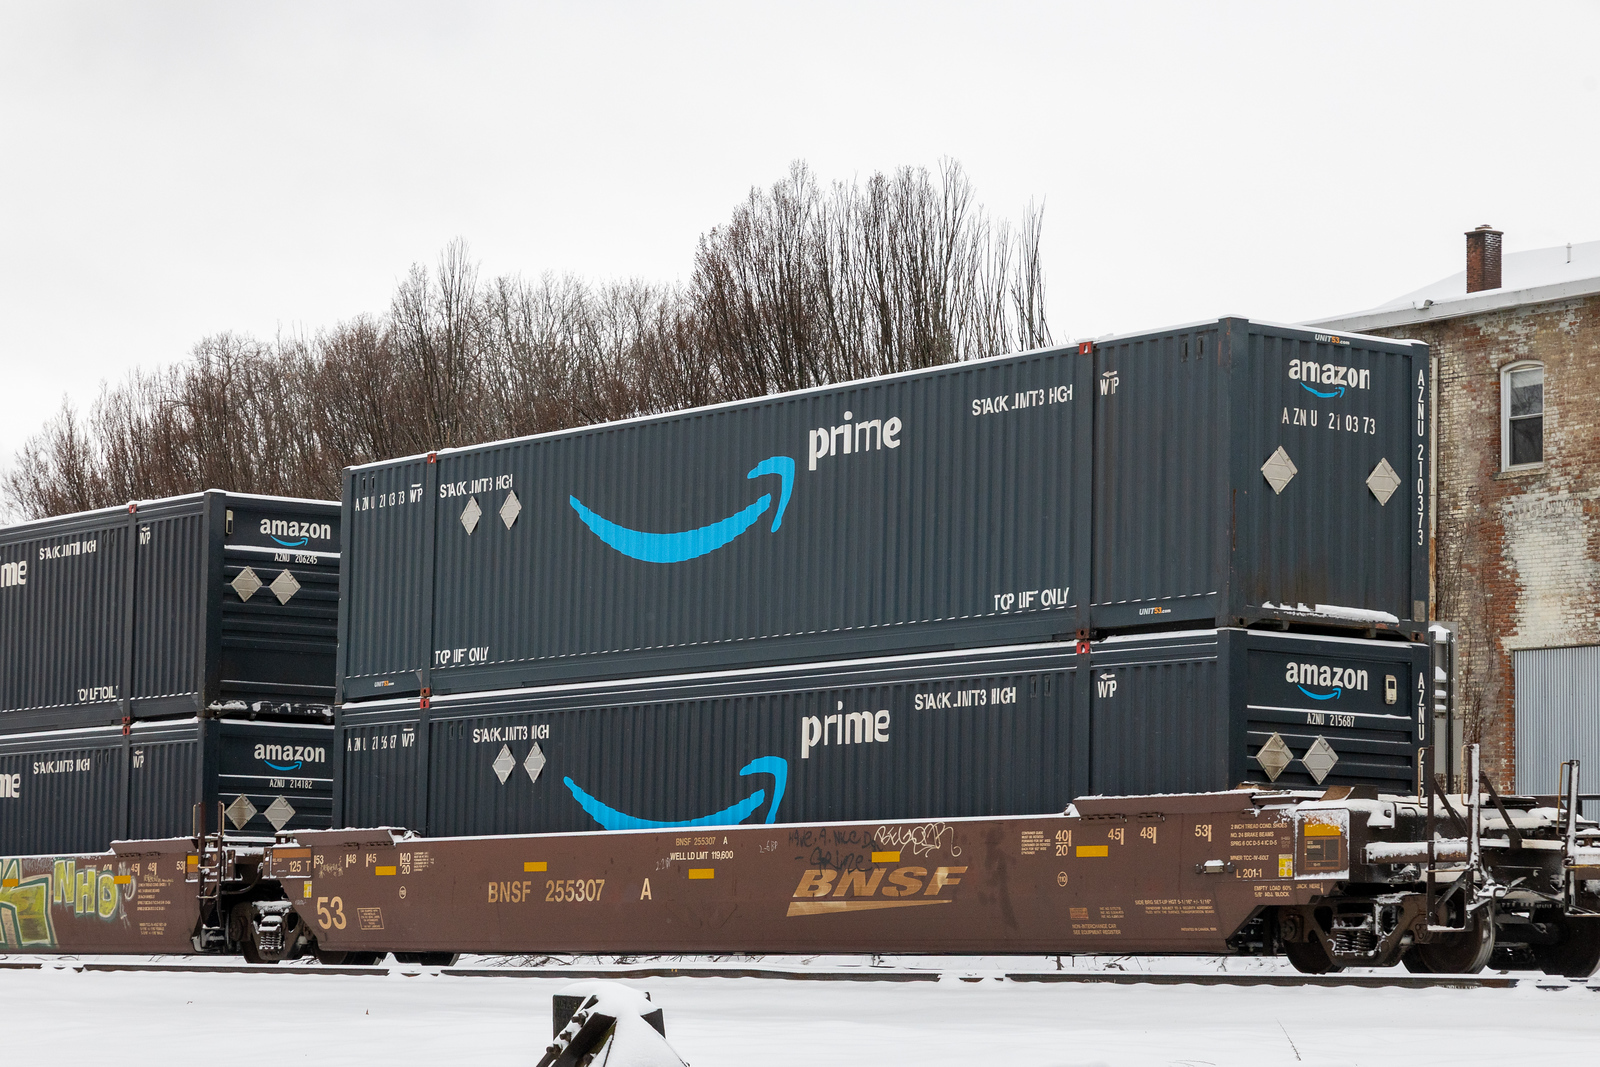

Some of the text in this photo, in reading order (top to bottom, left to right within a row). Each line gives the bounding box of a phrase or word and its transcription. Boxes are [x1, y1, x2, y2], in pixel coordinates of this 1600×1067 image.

[1288, 358, 1370, 389] amazon
[1417, 370, 1425, 436] AZNU
[1282, 406, 1376, 435] AZNU 210373
[808, 410, 902, 471] prime
[260, 518, 331, 540] amazon
[274, 553, 317, 564] AZNU 206245
[0, 561, 27, 587] me
[1286, 662, 1368, 691] amazon
[1307, 713, 1355, 727] AZNU 215687
[802, 700, 890, 759] prime
[254, 744, 325, 763] amazon
[0, 774, 20, 798] me
[269, 778, 312, 789] AZNU 214182
[1055, 830, 1068, 841] 40
[1108, 828, 1121, 840] 45
[1140, 827, 1153, 839] 48
[1195, 825, 1208, 837] 53
[676, 838, 691, 846] BNSF
[694, 837, 716, 845] 255307
[670, 852, 686, 860] WELL
[712, 851, 734, 860] 119,600
[1056, 845, 1068, 856] 20
[348, 854, 356, 863] 48
[368, 853, 377, 863] 45
[402, 852, 411, 862] 40
[289, 860, 301, 872] 125
[306, 860, 311, 872] T
[402, 865, 410, 874] 20
[1236, 868, 1262, 878] L 201-1
[792, 866, 968, 897] BNSF
[488, 878, 652, 903] BNSF 255307 A
[317, 896, 346, 930] 53
